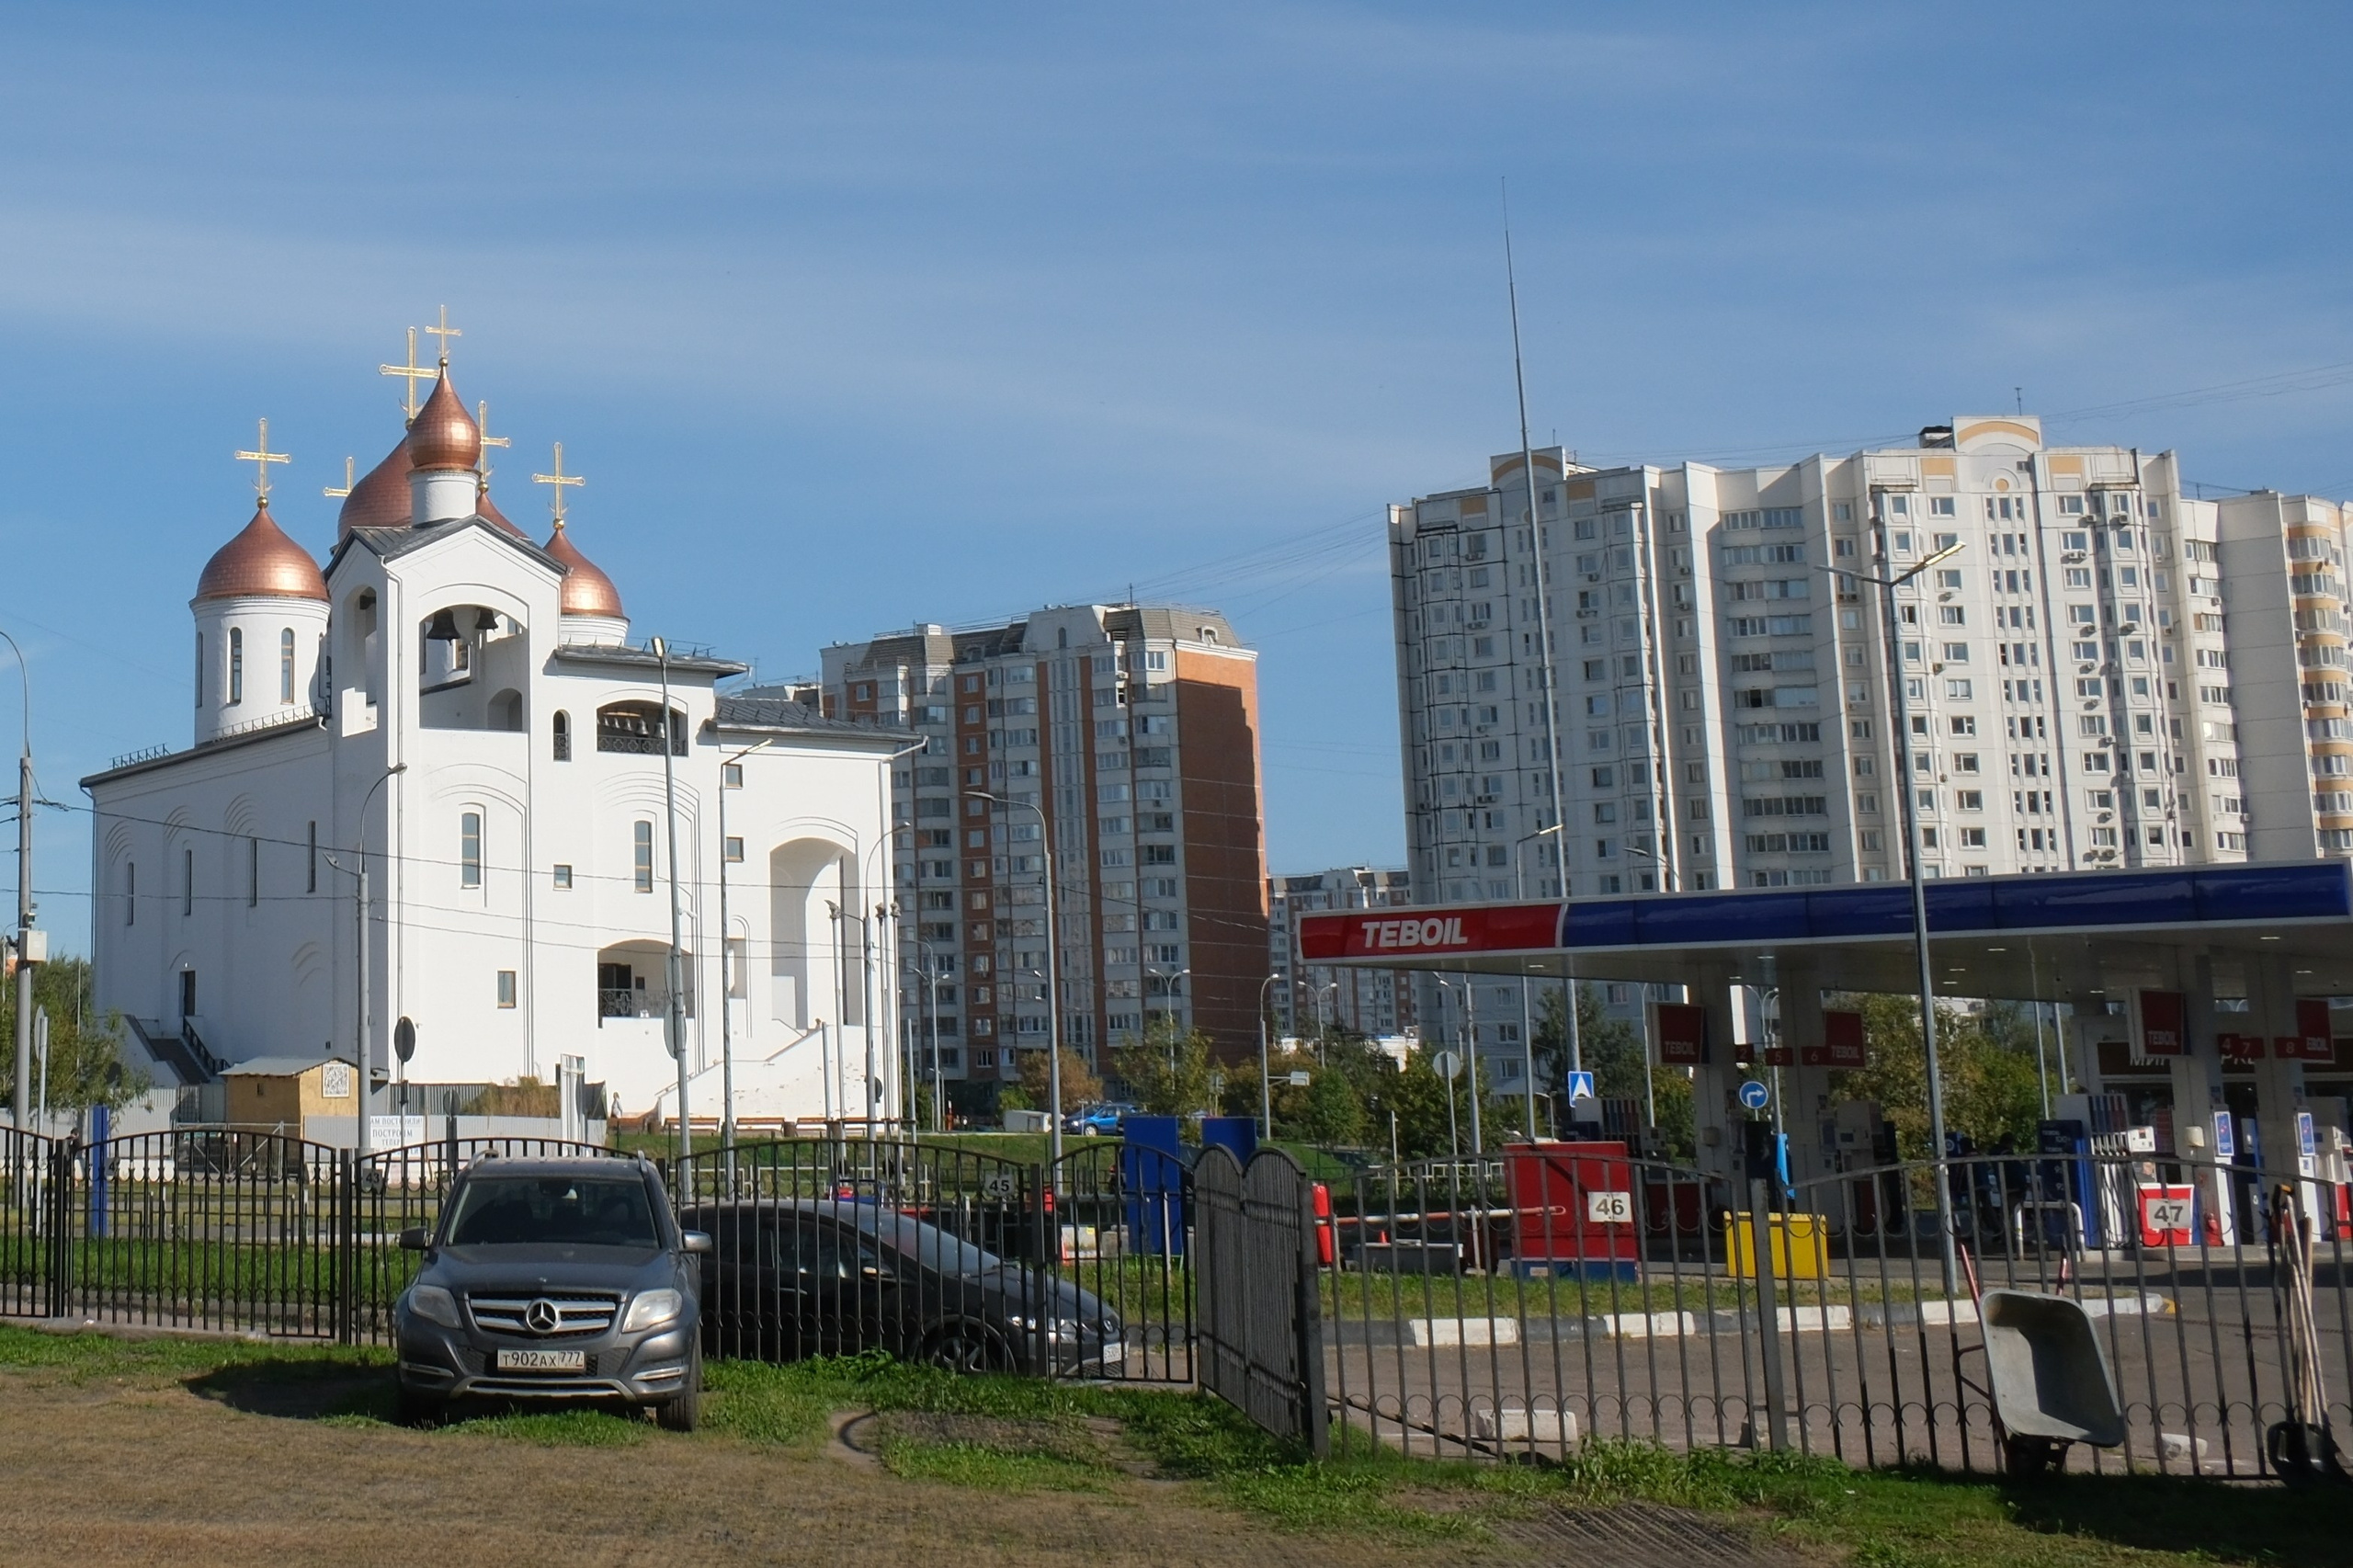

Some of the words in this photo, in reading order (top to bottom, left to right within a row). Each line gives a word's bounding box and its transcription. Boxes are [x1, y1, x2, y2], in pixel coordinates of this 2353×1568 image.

[1361, 917, 1468, 948] TEBOIL
[1665, 1040, 1696, 1055] TEBOIL
[2285, 1041, 2295, 1053] 8
[2305, 1037, 2329, 1051] EBOIL
[1811, 1051, 1819, 1062] 6
[366, 1172, 380, 1183] 43
[989, 1179, 1009, 1192] 45
[1596, 1199, 1624, 1215] 46
[2154, 1205, 2183, 1221] 47
